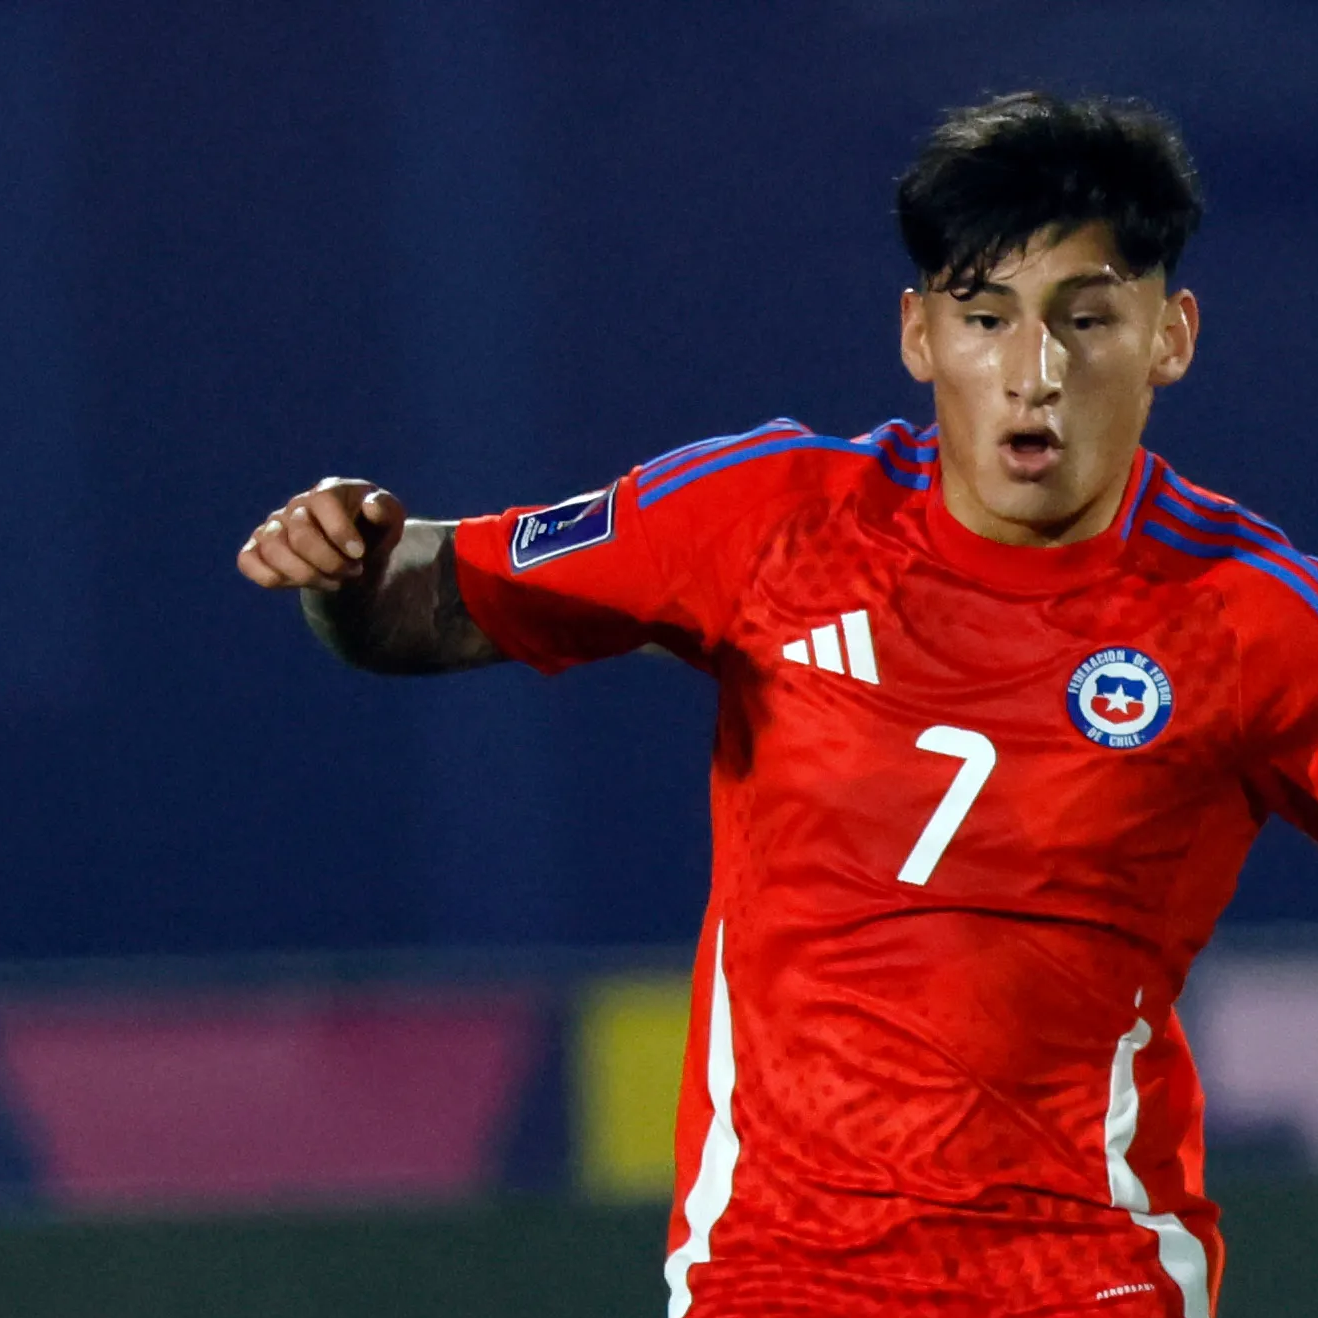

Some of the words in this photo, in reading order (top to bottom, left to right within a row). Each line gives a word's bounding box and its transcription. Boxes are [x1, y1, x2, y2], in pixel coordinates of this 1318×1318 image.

[1133, 653, 1150, 668] DE
[1087, 729, 1103, 743] DE
[897, 725, 996, 886] 7
